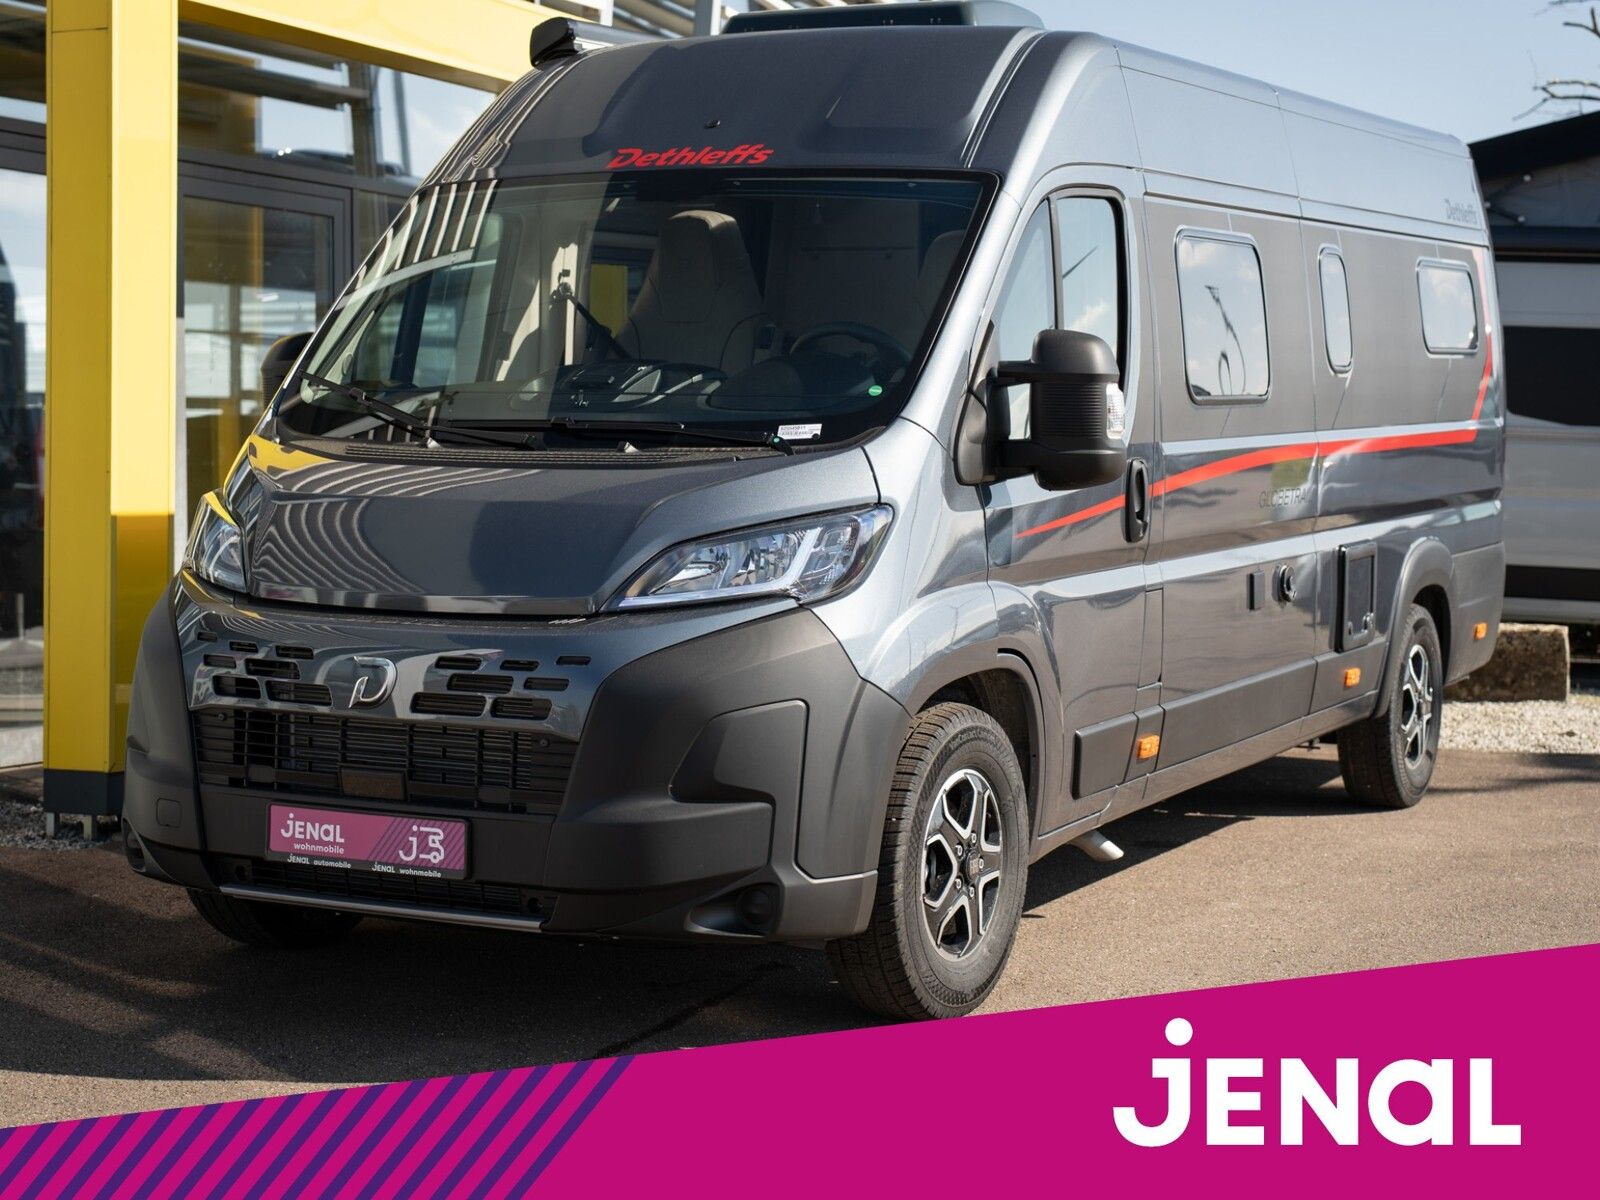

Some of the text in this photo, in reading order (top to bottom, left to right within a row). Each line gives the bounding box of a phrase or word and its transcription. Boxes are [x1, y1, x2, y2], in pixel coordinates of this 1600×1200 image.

[607, 143, 775, 169] Dethleffs
[293, 842, 345, 855] wohnmobile
[313, 859, 352, 869] automobile
[399, 867, 442, 878] wohnmobile
